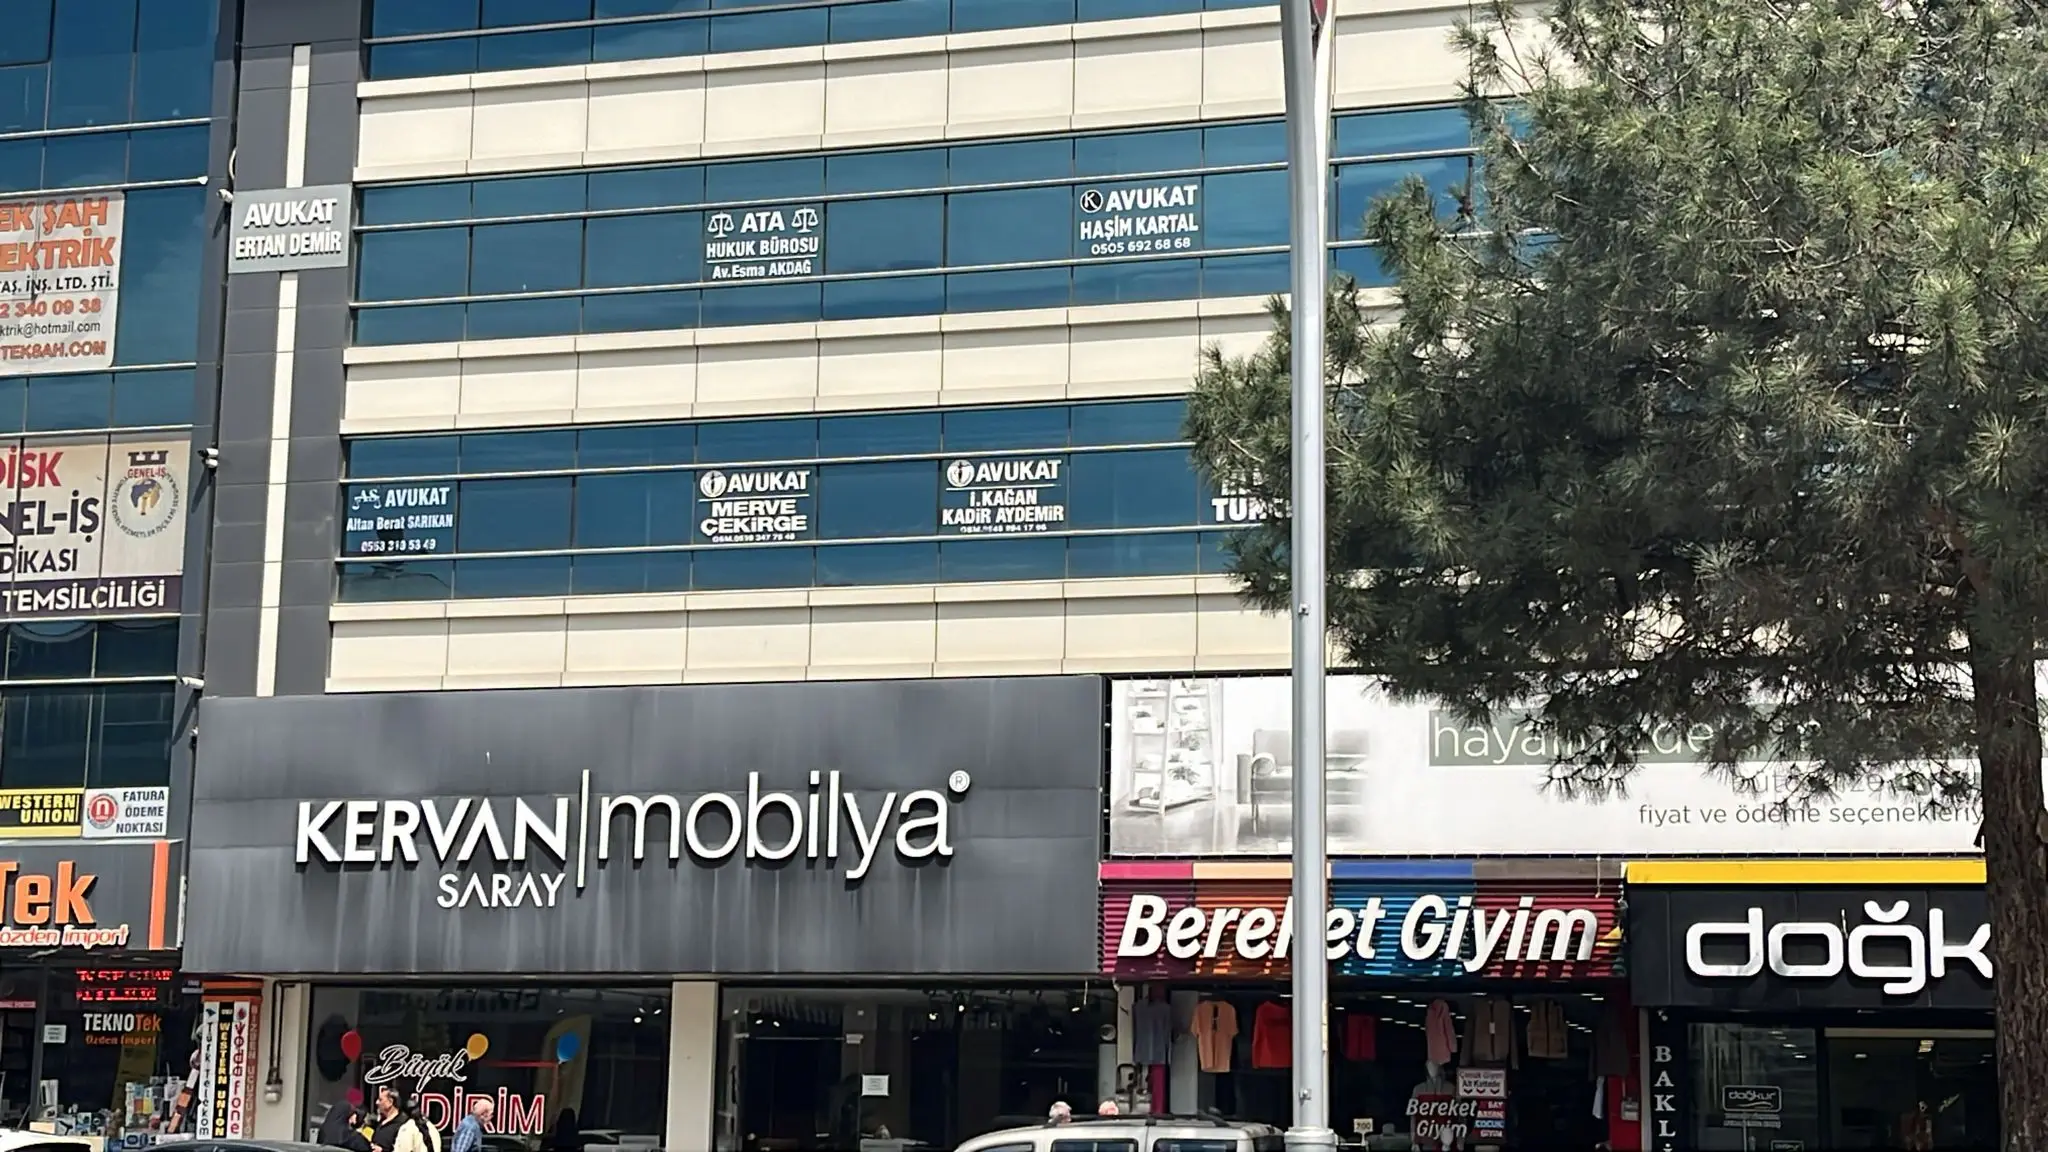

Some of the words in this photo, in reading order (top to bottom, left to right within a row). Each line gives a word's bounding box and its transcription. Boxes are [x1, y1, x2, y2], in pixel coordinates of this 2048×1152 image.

[1105, 185, 1198, 212] AVUKAT
[42, 196, 108, 236] ŞAH
[243, 198, 337, 229] AVUKAT
[740, 211, 785, 233] ATA
[1080, 215, 1133, 241] HAŞİM
[1135, 213, 1199, 236] KARTAL
[0, 228, 116, 272] EKTRİK
[235, 235, 286, 261] ERTAN
[289, 231, 342, 257] DEMİR
[706, 240, 756, 258] HUKUK
[759, 236, 819, 256] BÜROSU
[1091, 242, 1124, 255] 0505
[1127, 240, 1151, 252] 692
[1154, 239, 1171, 250] 68
[1174, 237, 1191, 248] 68
[712, 264, 765, 279] Av.Esma
[768, 259, 812, 276] AKDAĞ
[0, 279, 21, 295] AŞ.
[56, 277, 87, 290] LTD.
[91, 270, 114, 291] ŞTİ.
[727, 470, 811, 493] AVUKAT
[975, 460, 1062, 482] AVUKAT
[384, 487, 450, 508] AVUKAT
[711, 499, 797, 517] MERVE
[346, 517, 374, 532] Altan
[376, 516, 405, 530] Berat
[407, 514, 454, 529] SARIKAN
[0, 546, 78, 574] DİKASI
[2, 579, 165, 613] TEMSİLCİLİĞİ
[0, 795, 76, 809] WESTERN
[123, 790, 165, 803] FATURA
[20, 809, 76, 823] UNION
[125, 804, 164, 818] ÖDEME
[1639, 804, 1690, 828] fiyat
[1700, 809, 1727, 823] ve
[1736, 804, 1820, 824] ödeme
[116, 822, 163, 834] NOKTASI
[295, 797, 569, 863] KERVAN
[598, 770, 954, 880] mobilya
[437, 872, 566, 908] SARAY
[1400, 893, 1597, 974] Giyim
[218, 1022, 231, 1085] WESTERN
[365, 1044, 468, 1093] Büyük
[199, 1069, 211, 1135] Telekom
[215, 1090, 226, 1136] UNION
[1405, 1098, 1477, 1117] Bereket
